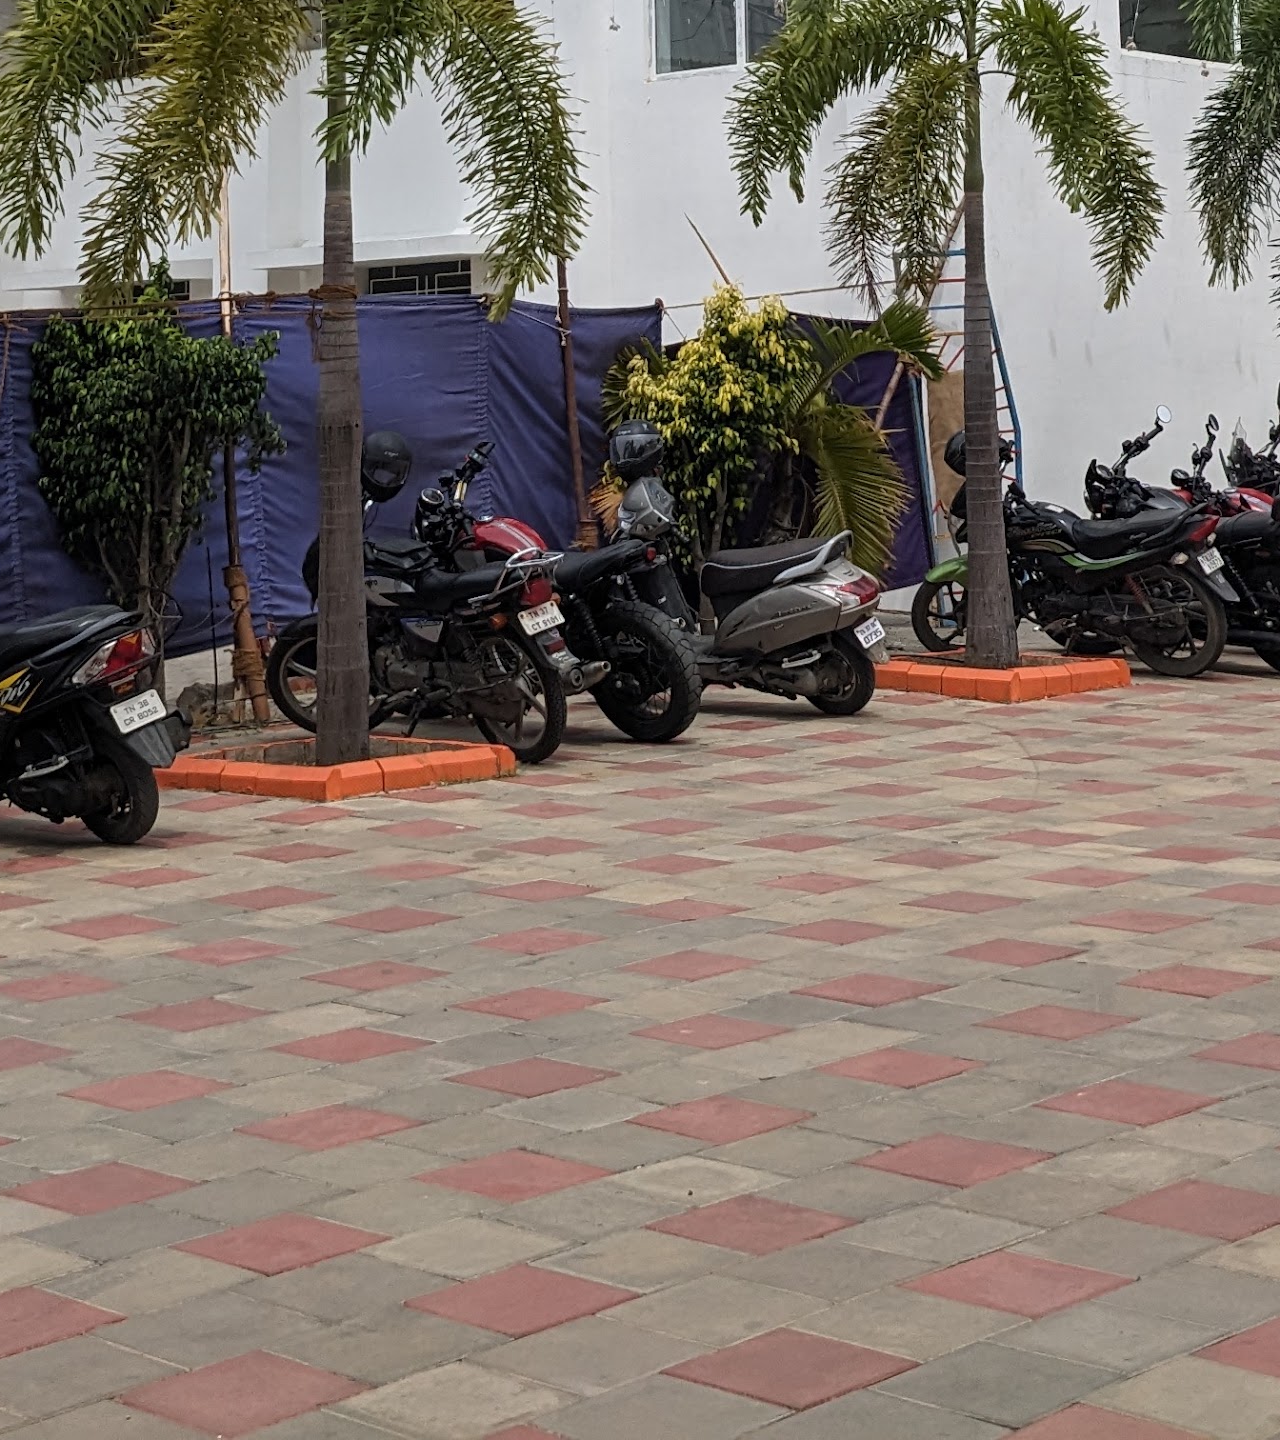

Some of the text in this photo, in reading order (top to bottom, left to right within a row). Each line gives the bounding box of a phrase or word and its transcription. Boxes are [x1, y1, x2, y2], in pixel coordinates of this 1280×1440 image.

[531, 621, 542, 631] CT
[862, 627, 883, 645] 0735
[123, 705, 136, 715] TN
[138, 706, 159, 721] 8052
